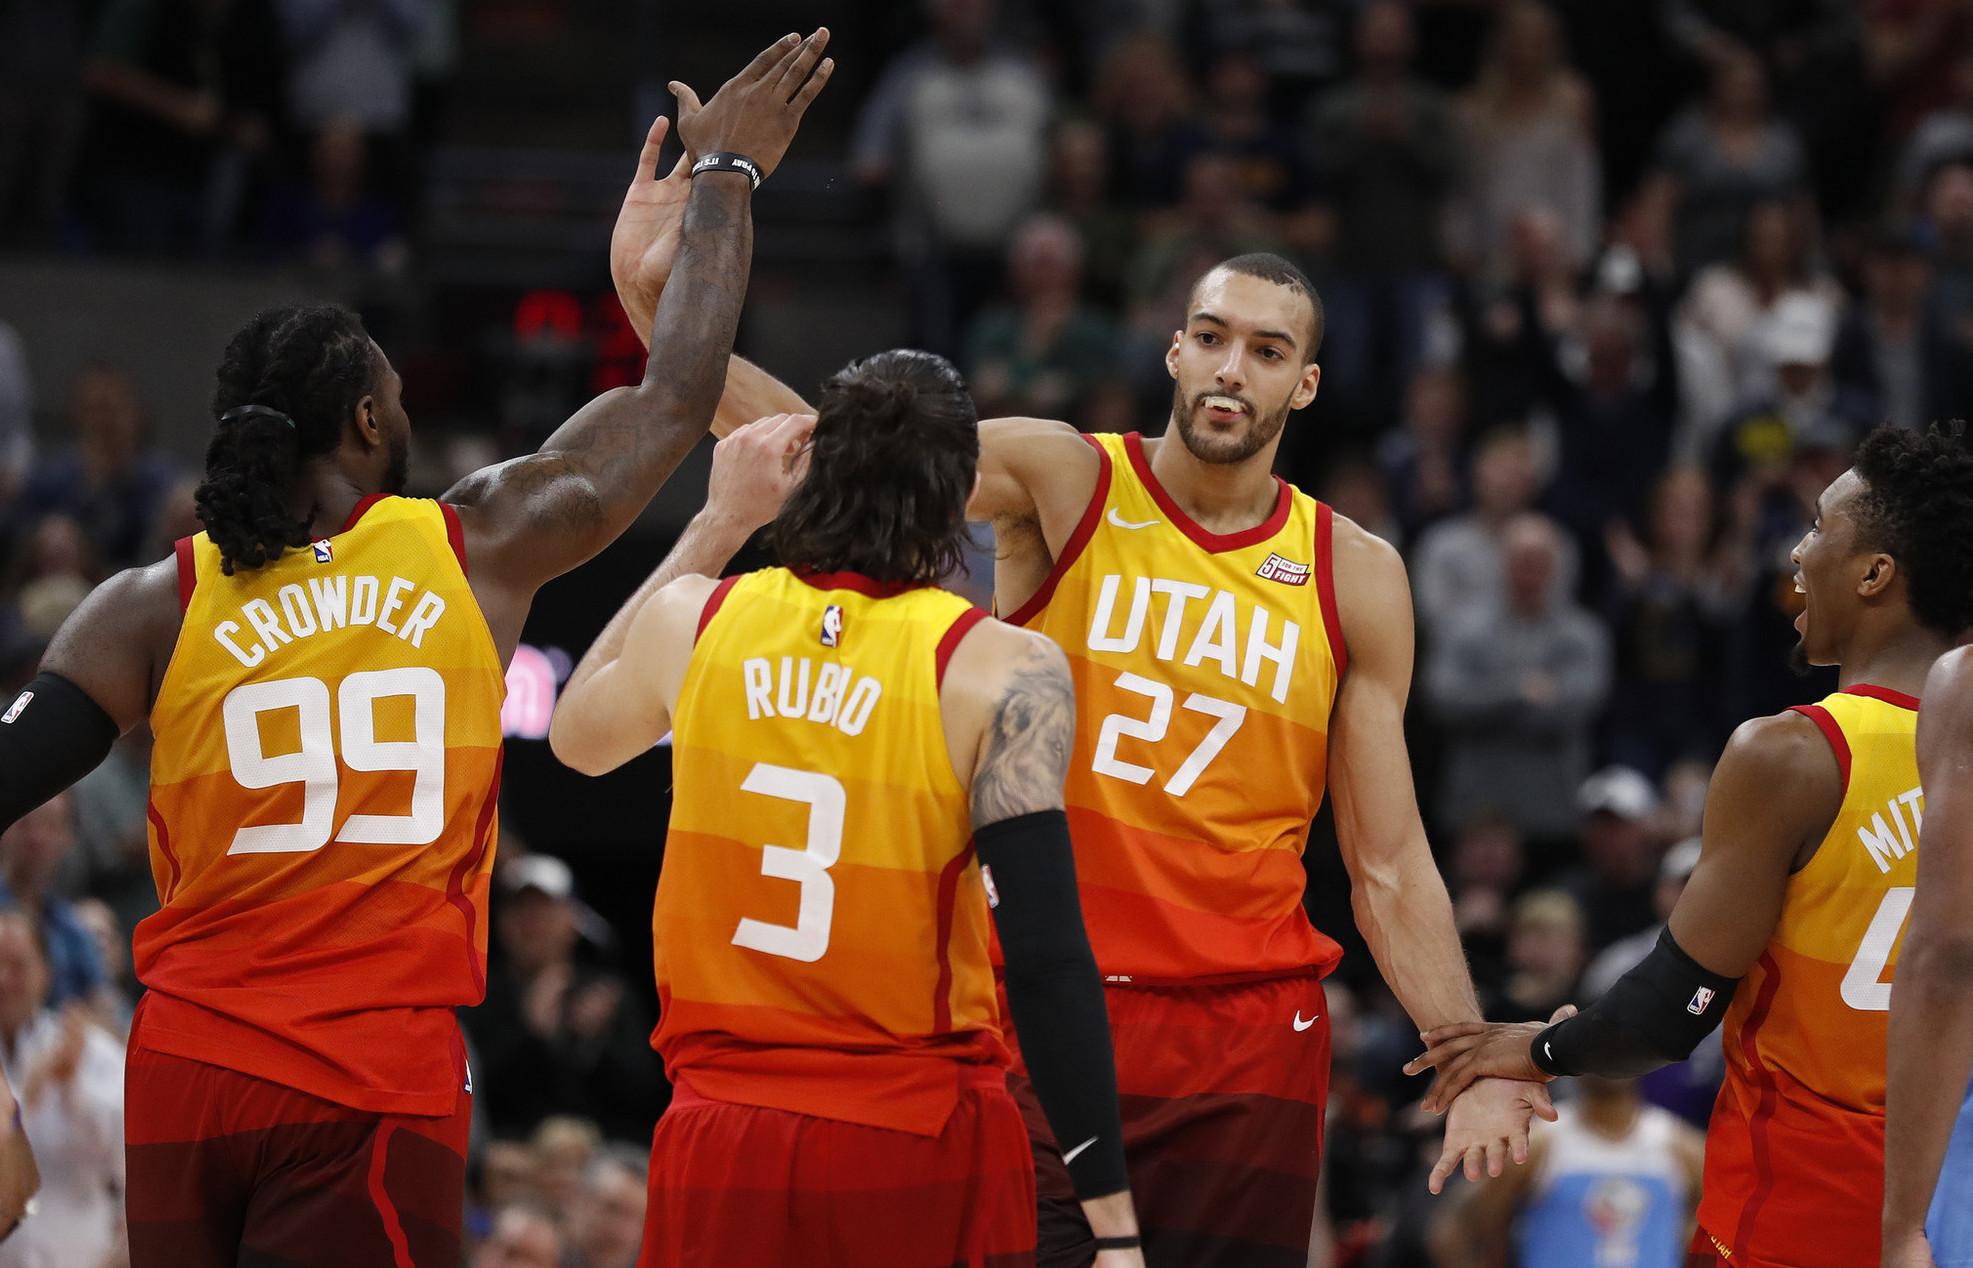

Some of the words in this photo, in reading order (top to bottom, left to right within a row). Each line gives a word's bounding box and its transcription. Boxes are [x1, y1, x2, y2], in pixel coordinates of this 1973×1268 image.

[1262, 556, 1278, 575] 5
[1274, 570, 1306, 584] FIGHT
[214, 575, 446, 668] CROWDER
[1087, 574, 1300, 705] UTAH
[743, 656, 882, 737] RUBIO
[1091, 671, 1248, 797] 27
[222, 666, 446, 856] 99
[730, 761, 847, 963] 3
